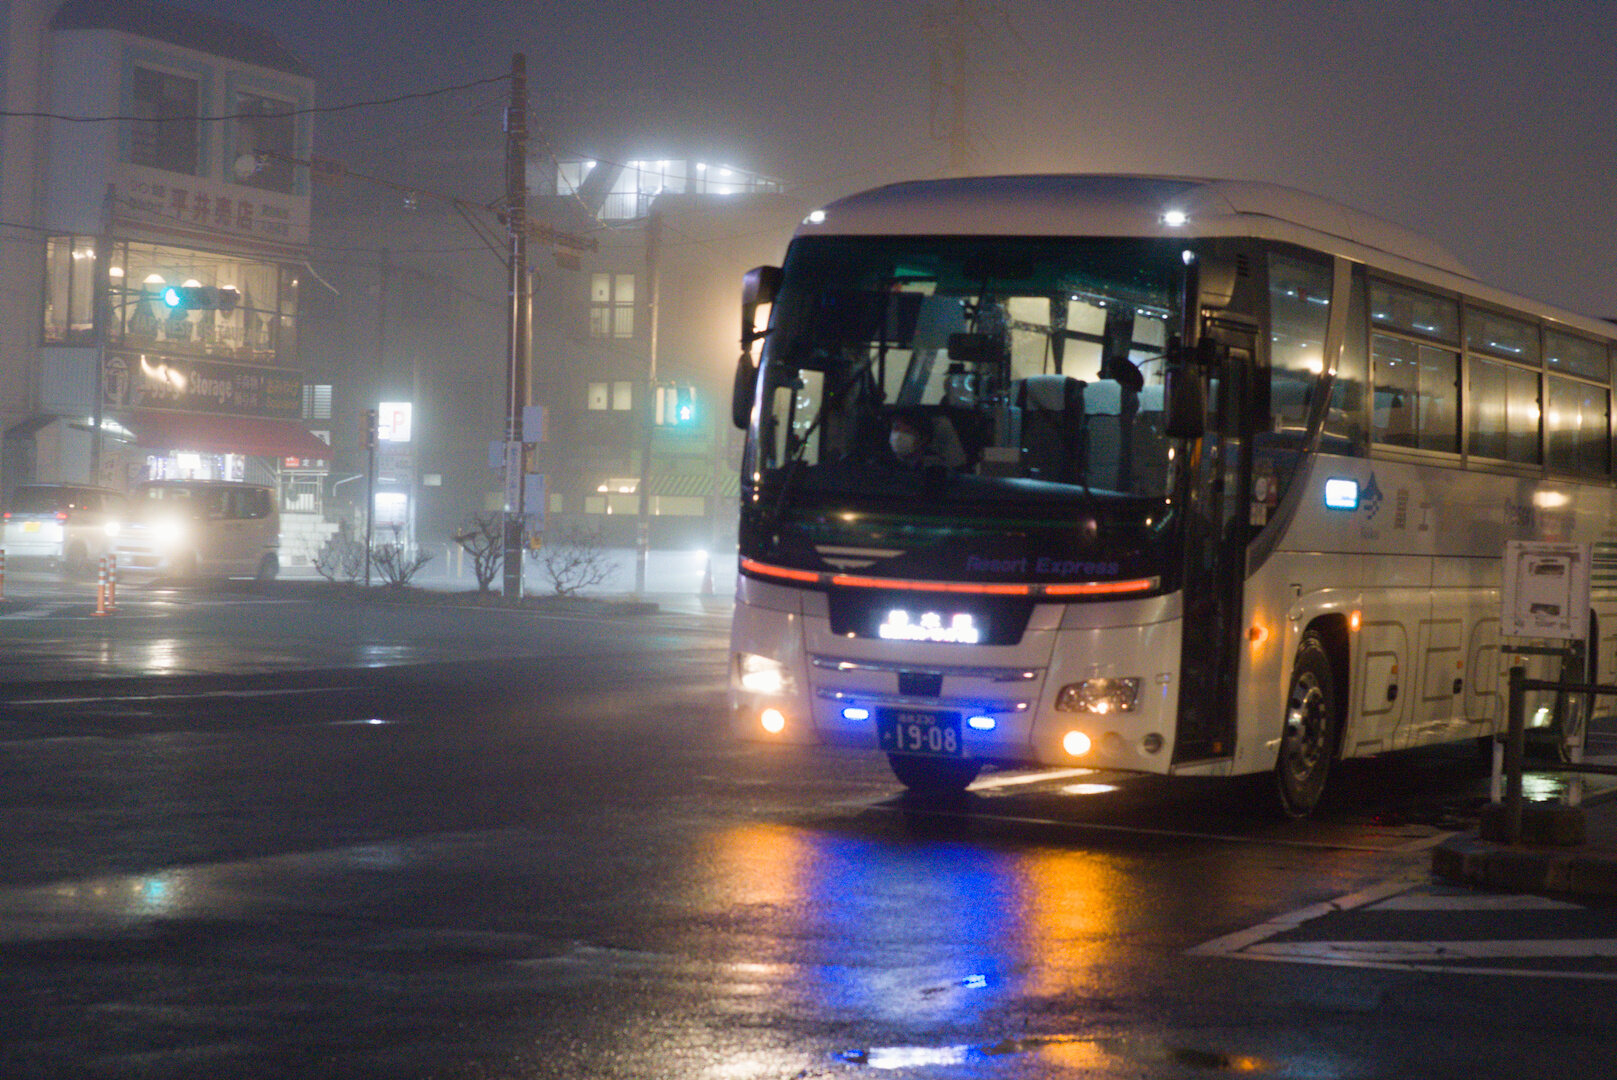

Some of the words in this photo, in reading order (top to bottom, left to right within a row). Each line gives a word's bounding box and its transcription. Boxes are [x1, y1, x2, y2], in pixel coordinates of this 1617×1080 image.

[190, 371, 233, 404] Storage
[393, 411, 406, 433] P
[966, 555, 1027, 573] Resort
[1035, 556, 1119, 576] Express
